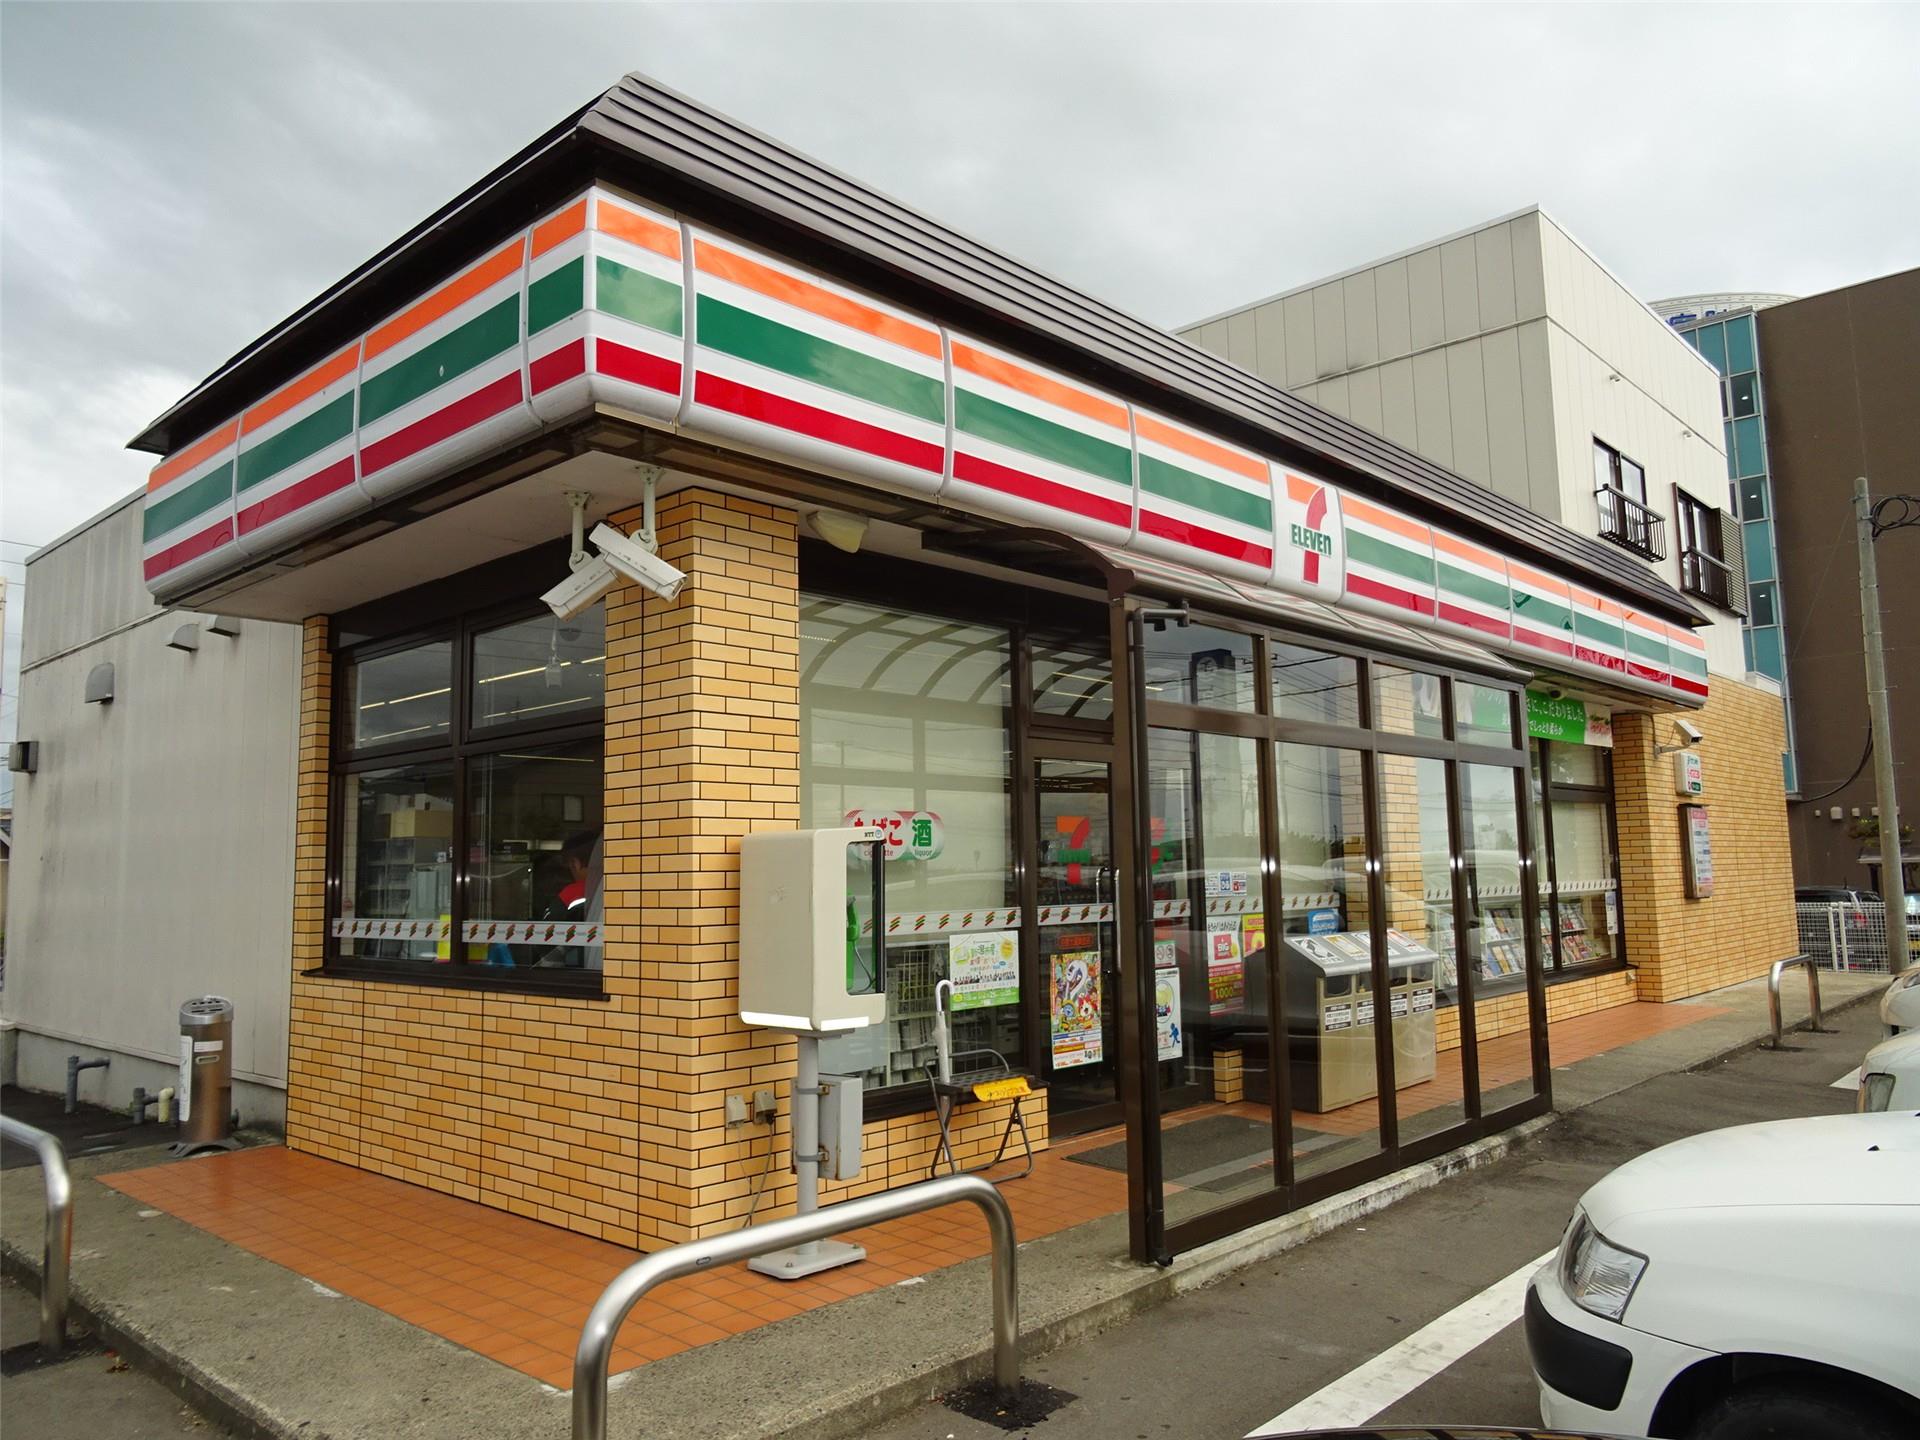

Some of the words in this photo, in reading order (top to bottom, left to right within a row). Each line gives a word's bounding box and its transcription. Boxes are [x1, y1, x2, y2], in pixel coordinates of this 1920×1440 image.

[1286, 474, 1328, 585] 7
[911, 818, 933, 848] 酒
[914, 849, 933, 858] liquor
